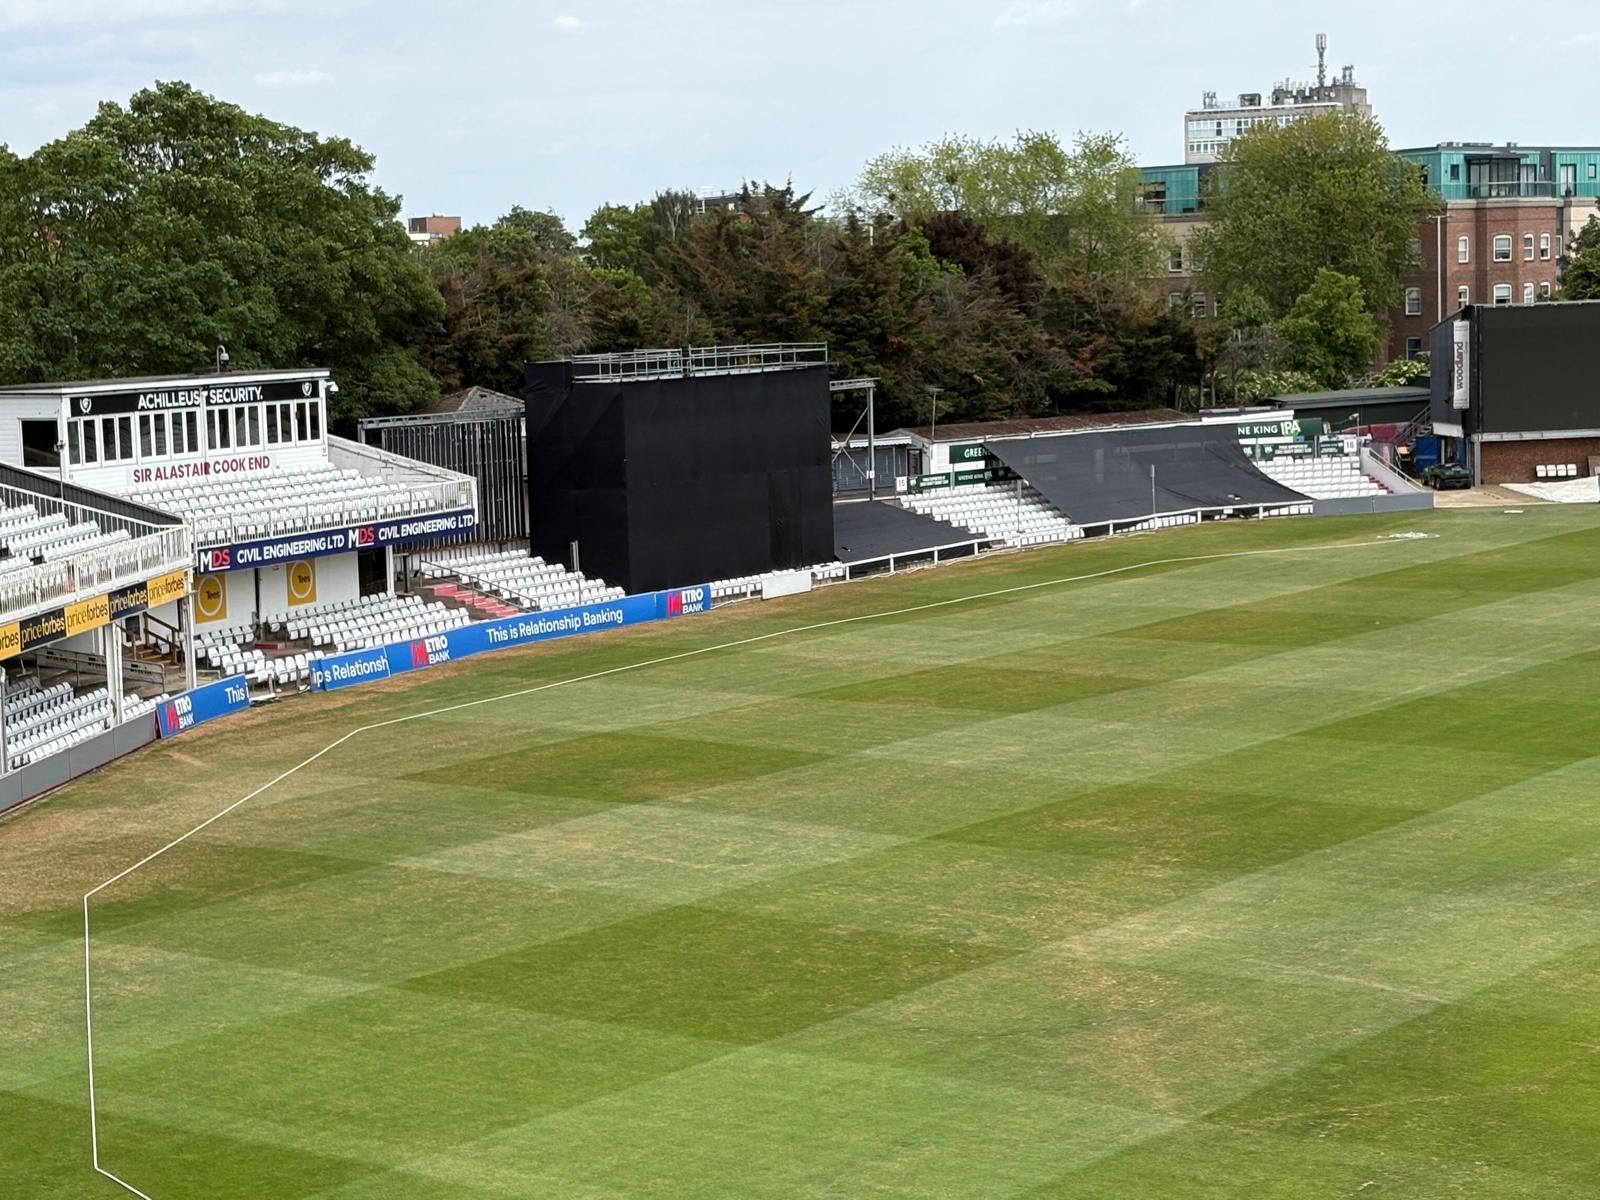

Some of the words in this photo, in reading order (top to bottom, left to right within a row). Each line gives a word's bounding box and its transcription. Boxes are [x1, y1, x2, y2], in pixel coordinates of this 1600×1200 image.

[1455, 341, 1464, 390] woodland
[138, 391, 200, 409] ACHILLEUS
[1253, 425, 1278, 434] KING
[1280, 420, 1301, 435] IPA
[133, 468, 153, 483] SIR
[154, 462, 211, 480] ALASTAIR
[213, 458, 246, 474] COOK
[248, 456, 271, 470] END
[348, 527, 374, 548] MDS
[378, 526, 400, 541] CIVIL
[401, 516, 456, 536] ENGINEERING
[458, 514, 474, 528] LTD
[200, 549, 231, 573] MDS
[237, 547, 262, 563] CIVIL
[263, 537, 326, 560] ENGINEERING
[327, 534, 345, 549] LTD
[66, 602, 109, 633] priceforbes
[667, 588, 703, 618] METRO
[682, 602, 703, 614] BANK
[21, 616, 65, 649] priceforbes
[486, 625, 508, 643] This
[510, 622, 519, 639] is
[519, 612, 581, 637] Relationship
[583, 607, 623, 626] Banking
[411, 635, 448, 669] METRO
[429, 650, 450, 665] BANK
[332, 655, 388, 680] Relationsh
[225, 684, 245, 704] This
[165, 695, 192, 734] METRO
[179, 712, 195, 729] BANK
